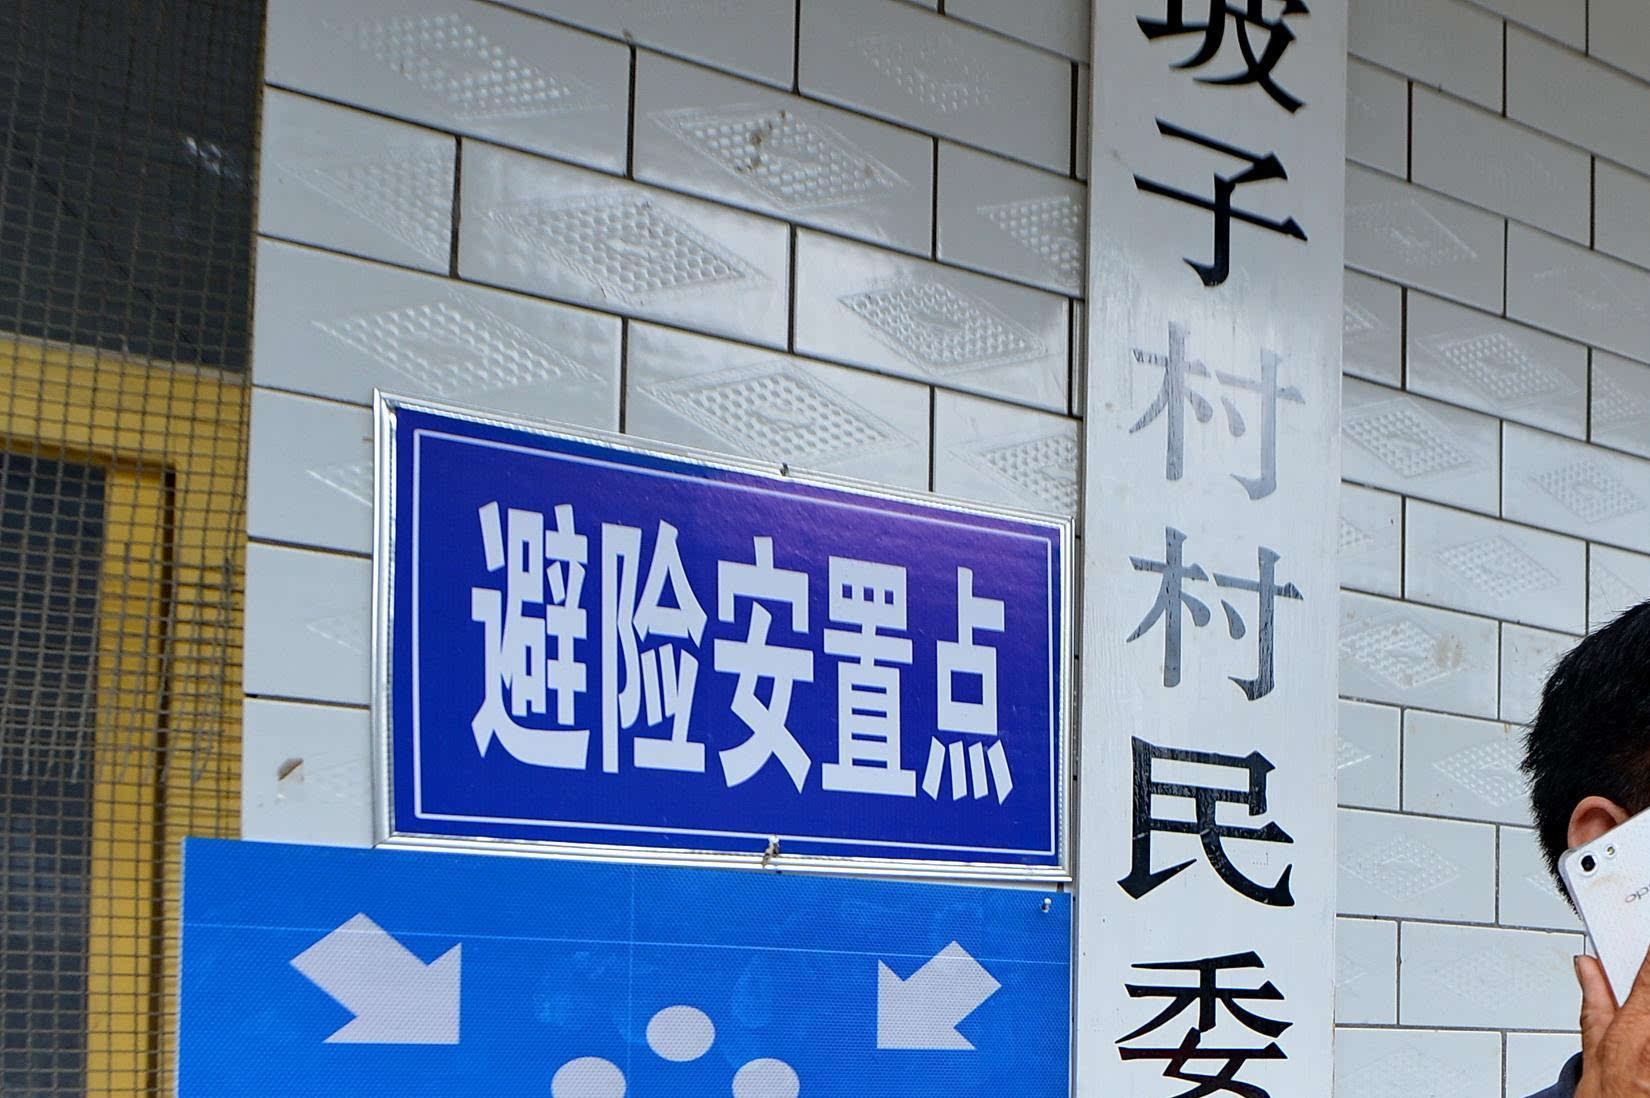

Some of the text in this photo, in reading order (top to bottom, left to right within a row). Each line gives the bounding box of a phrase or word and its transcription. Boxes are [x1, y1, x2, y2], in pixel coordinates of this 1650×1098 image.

[470, 500, 1014, 806] 避险安置点
